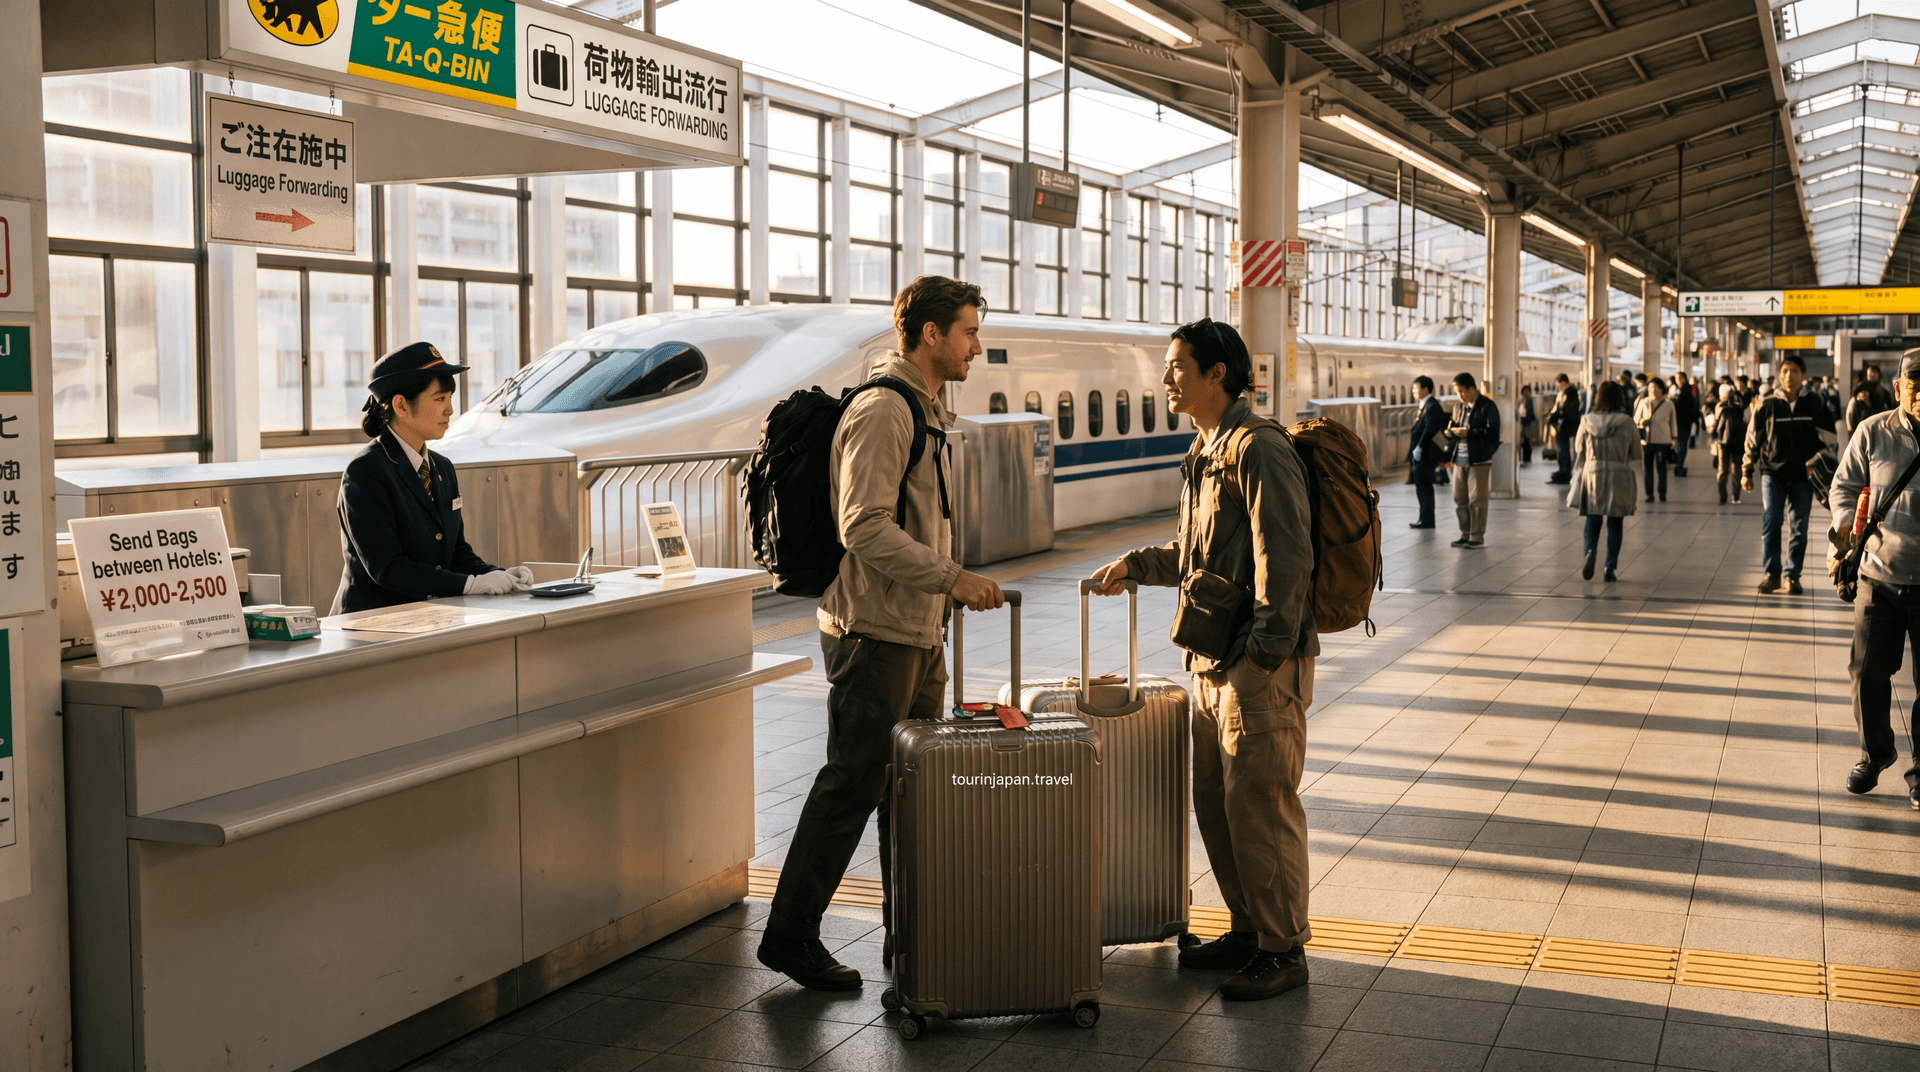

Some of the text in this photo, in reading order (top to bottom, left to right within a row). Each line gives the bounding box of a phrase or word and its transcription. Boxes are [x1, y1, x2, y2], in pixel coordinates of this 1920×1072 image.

[384, 36, 490, 84] TA-Q-BIN
[584, 42, 728, 114] 荷物輸出流行
[584, 90, 728, 141] LUGGAGE FORWARDING
[220, 122, 347, 170] ご注在施中
[217, 164, 348, 204] Luggage Forwarding
[109, 529, 198, 551] Send Bags
[91, 549, 223, 579] between Hotels:
[100, 575, 227, 612] ¥2,000-2,500
